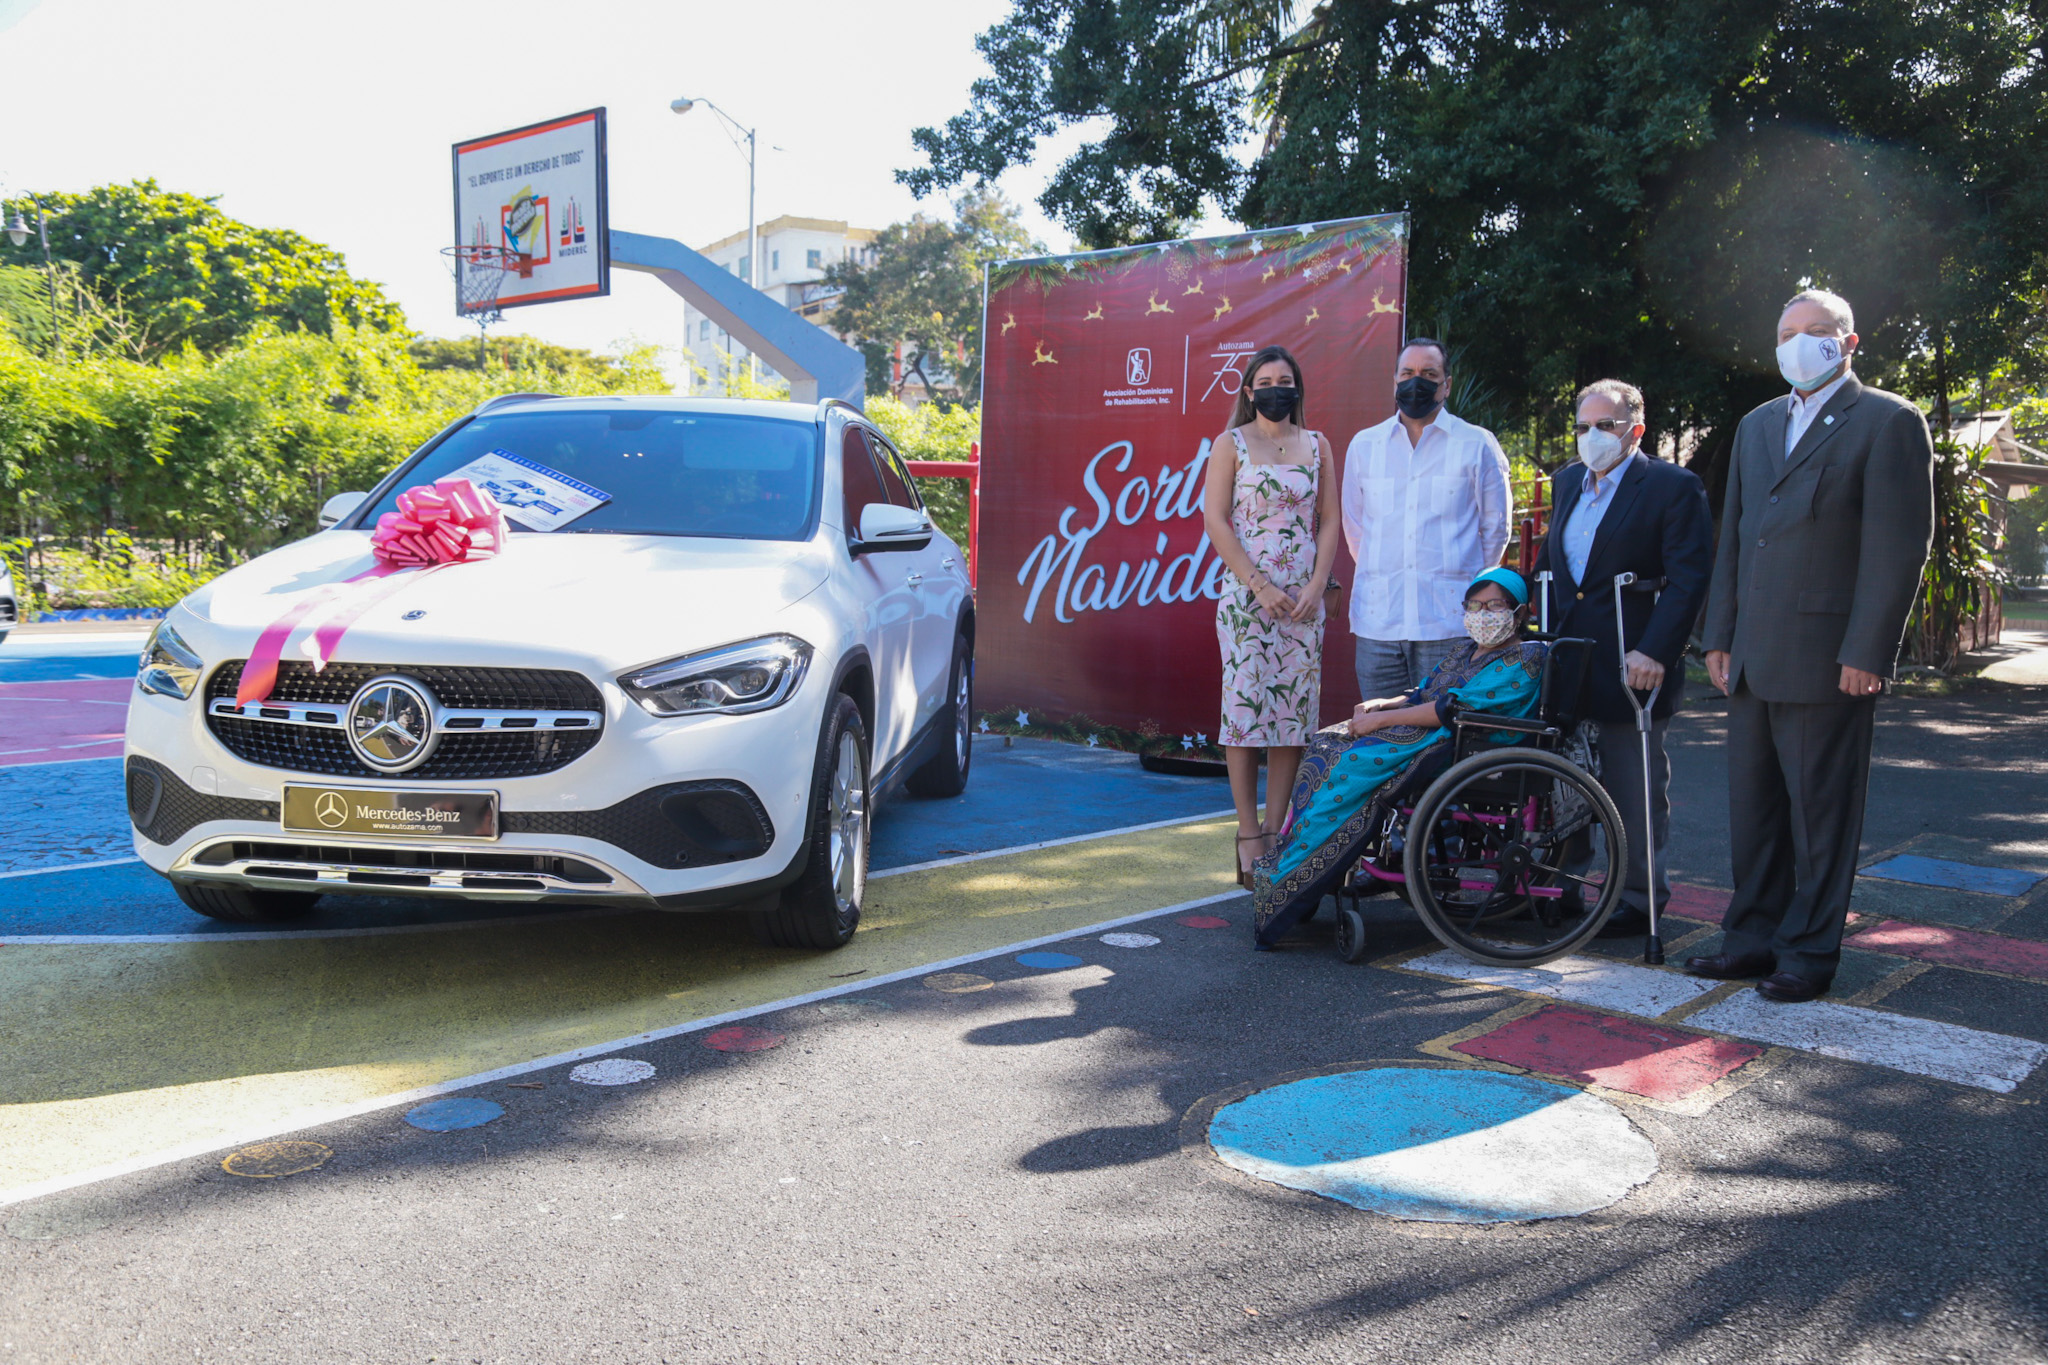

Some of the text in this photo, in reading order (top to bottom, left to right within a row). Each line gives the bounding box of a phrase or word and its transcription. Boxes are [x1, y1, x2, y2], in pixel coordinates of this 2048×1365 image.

[479, 169, 504, 185] DEPORTE
[506, 167, 513, 180] ES
[515, 165, 522, 177] UN
[524, 158, 551, 175] DERECHO
[552, 156, 560, 169] DE
[559, 245, 588, 257] MIDEREC
[1217, 341, 1255, 351] Autozama
[1200, 351, 1257, 402] 75
[1103, 387, 1174, 397] Asociación Dominicana
[1114, 397, 1158, 405] Rehabilitación,
[1058, 437, 1211, 540] Sort
[1017, 527, 1227, 624] Navide
[356, 805, 460, 823] Mercedes-Benz
[372, 823, 444, 831] www.autozama.com
